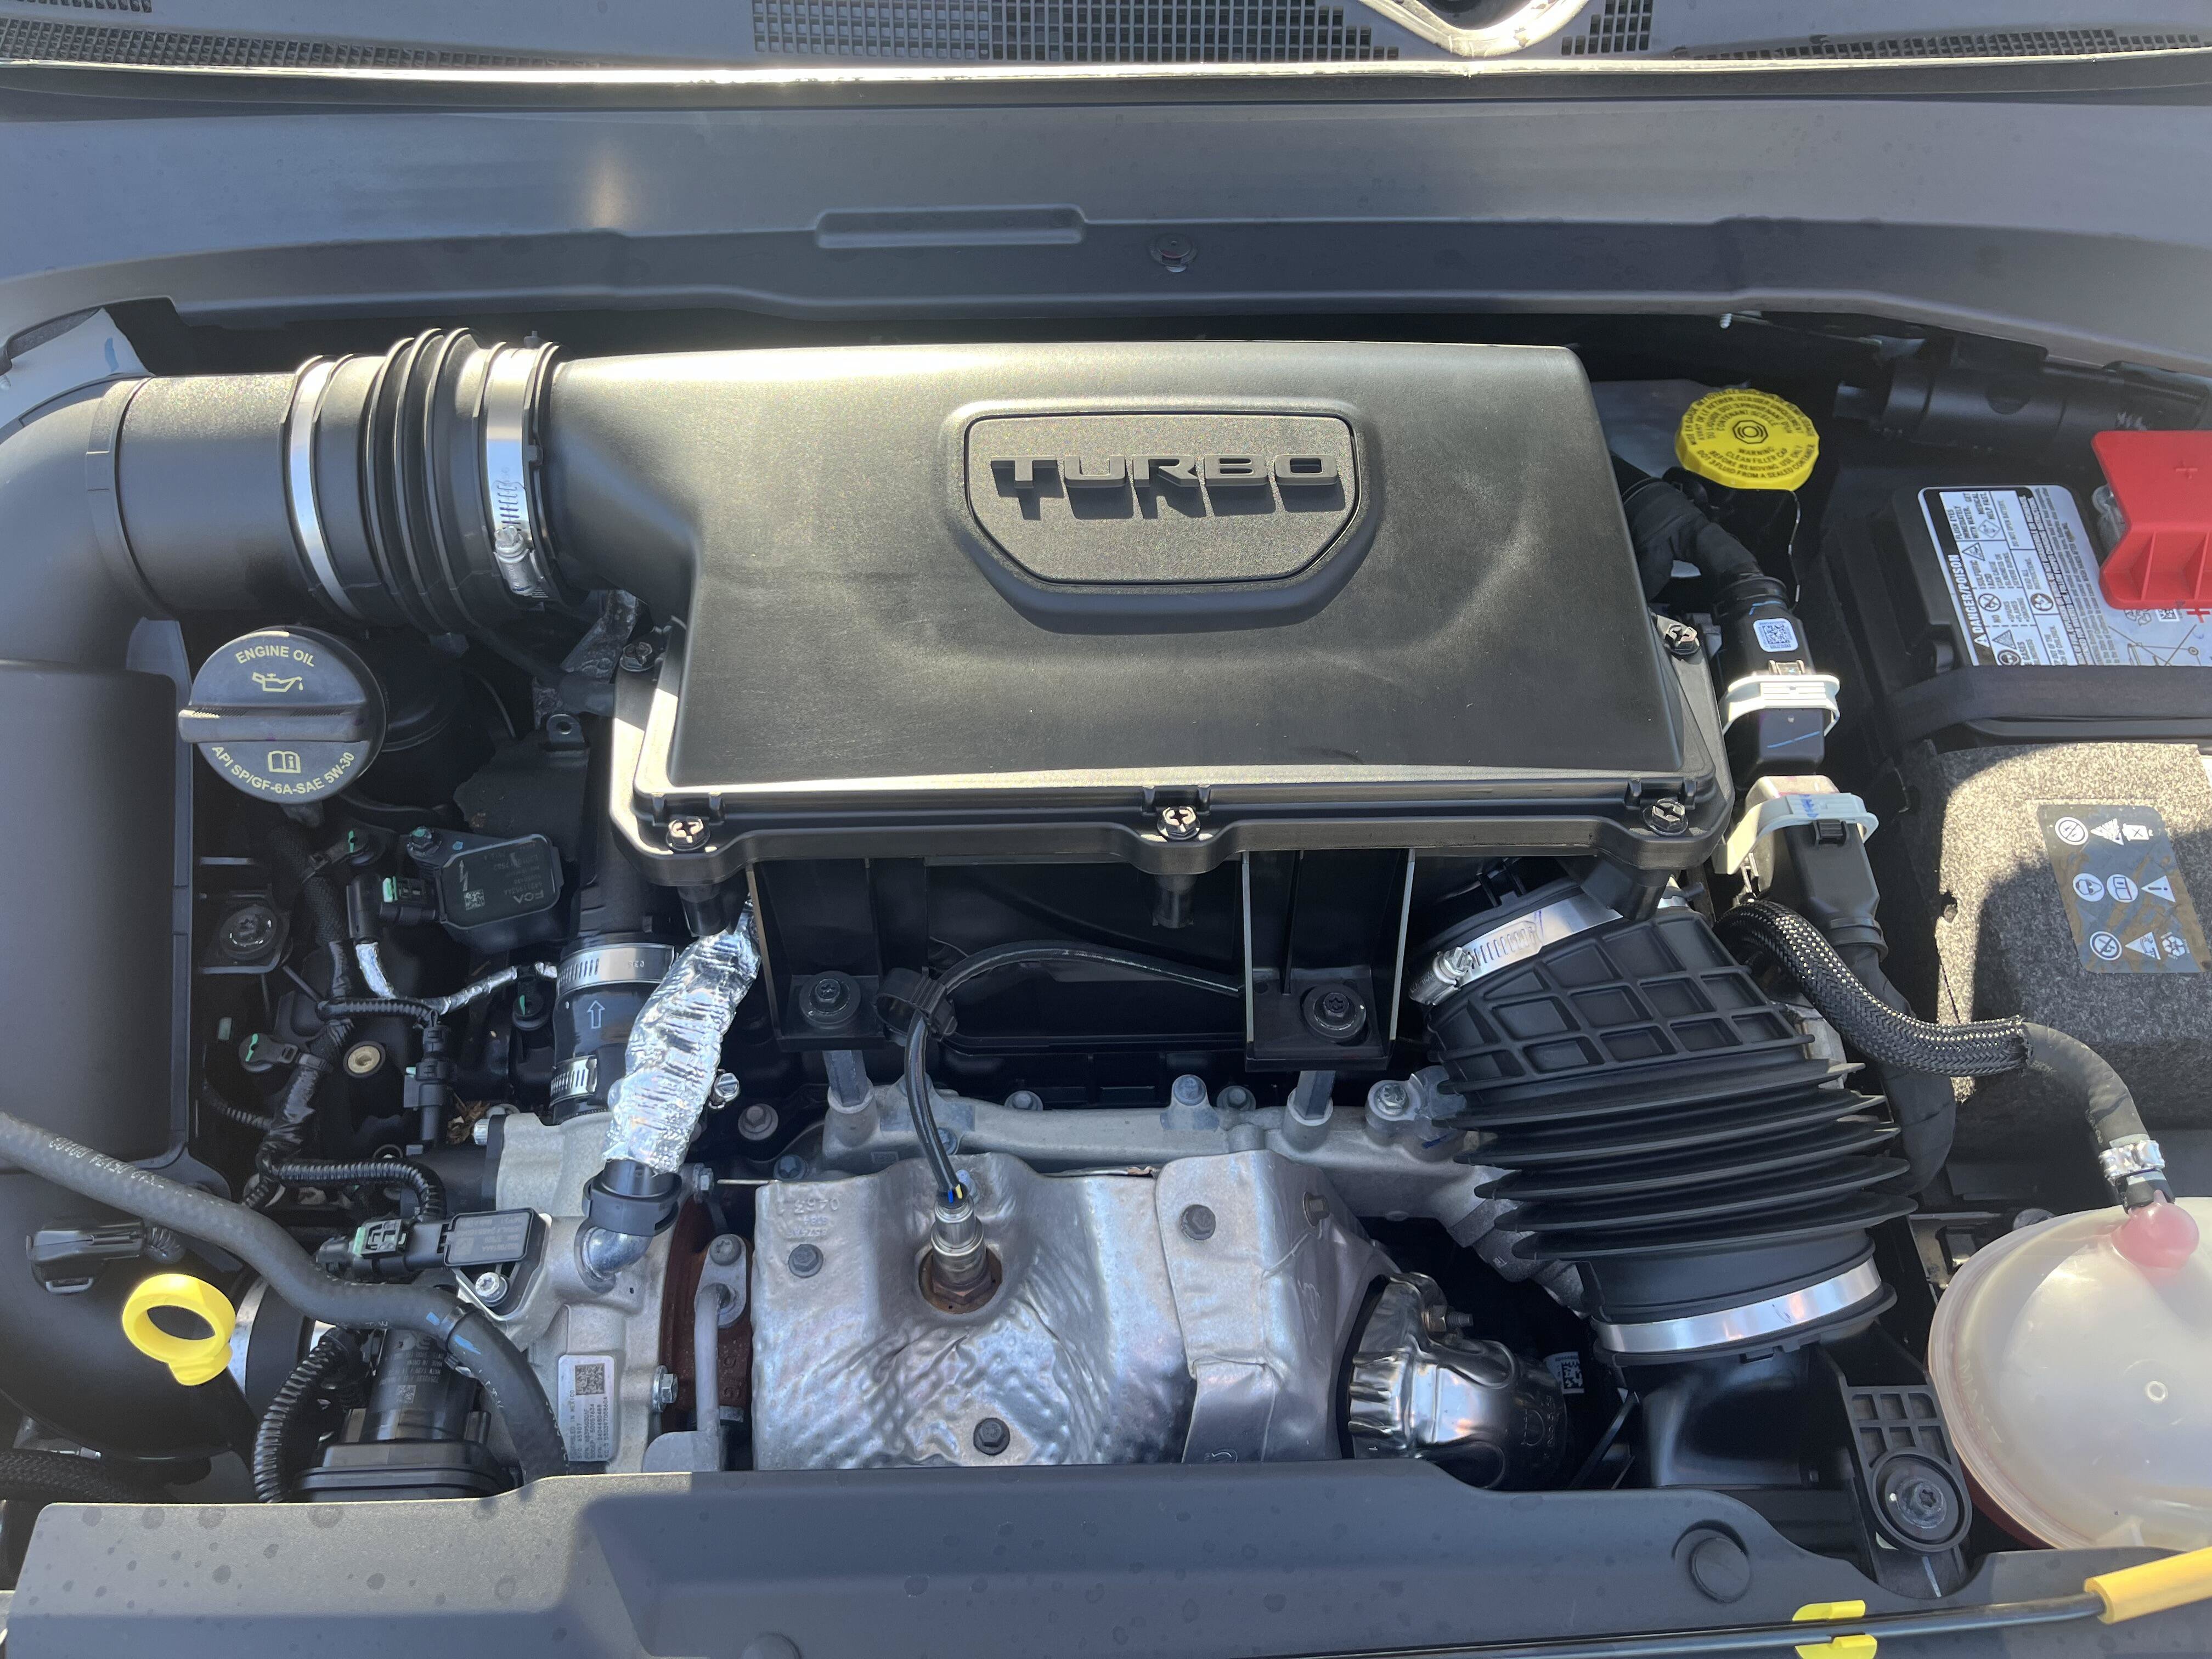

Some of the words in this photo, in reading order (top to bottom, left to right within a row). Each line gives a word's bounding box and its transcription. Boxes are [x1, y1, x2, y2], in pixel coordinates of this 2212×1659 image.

[990, 454, 1339, 488] TURBO
[1946, 554, 1985, 633] DANGER/POISON
[235, 645, 289, 664] ENGINE
[293, 649, 315, 667] OIL
[212, 746, 233, 766] API
[231, 765, 325, 794] SP/GF-6A-SAE
[324, 752, 355, 783] 5W-30
